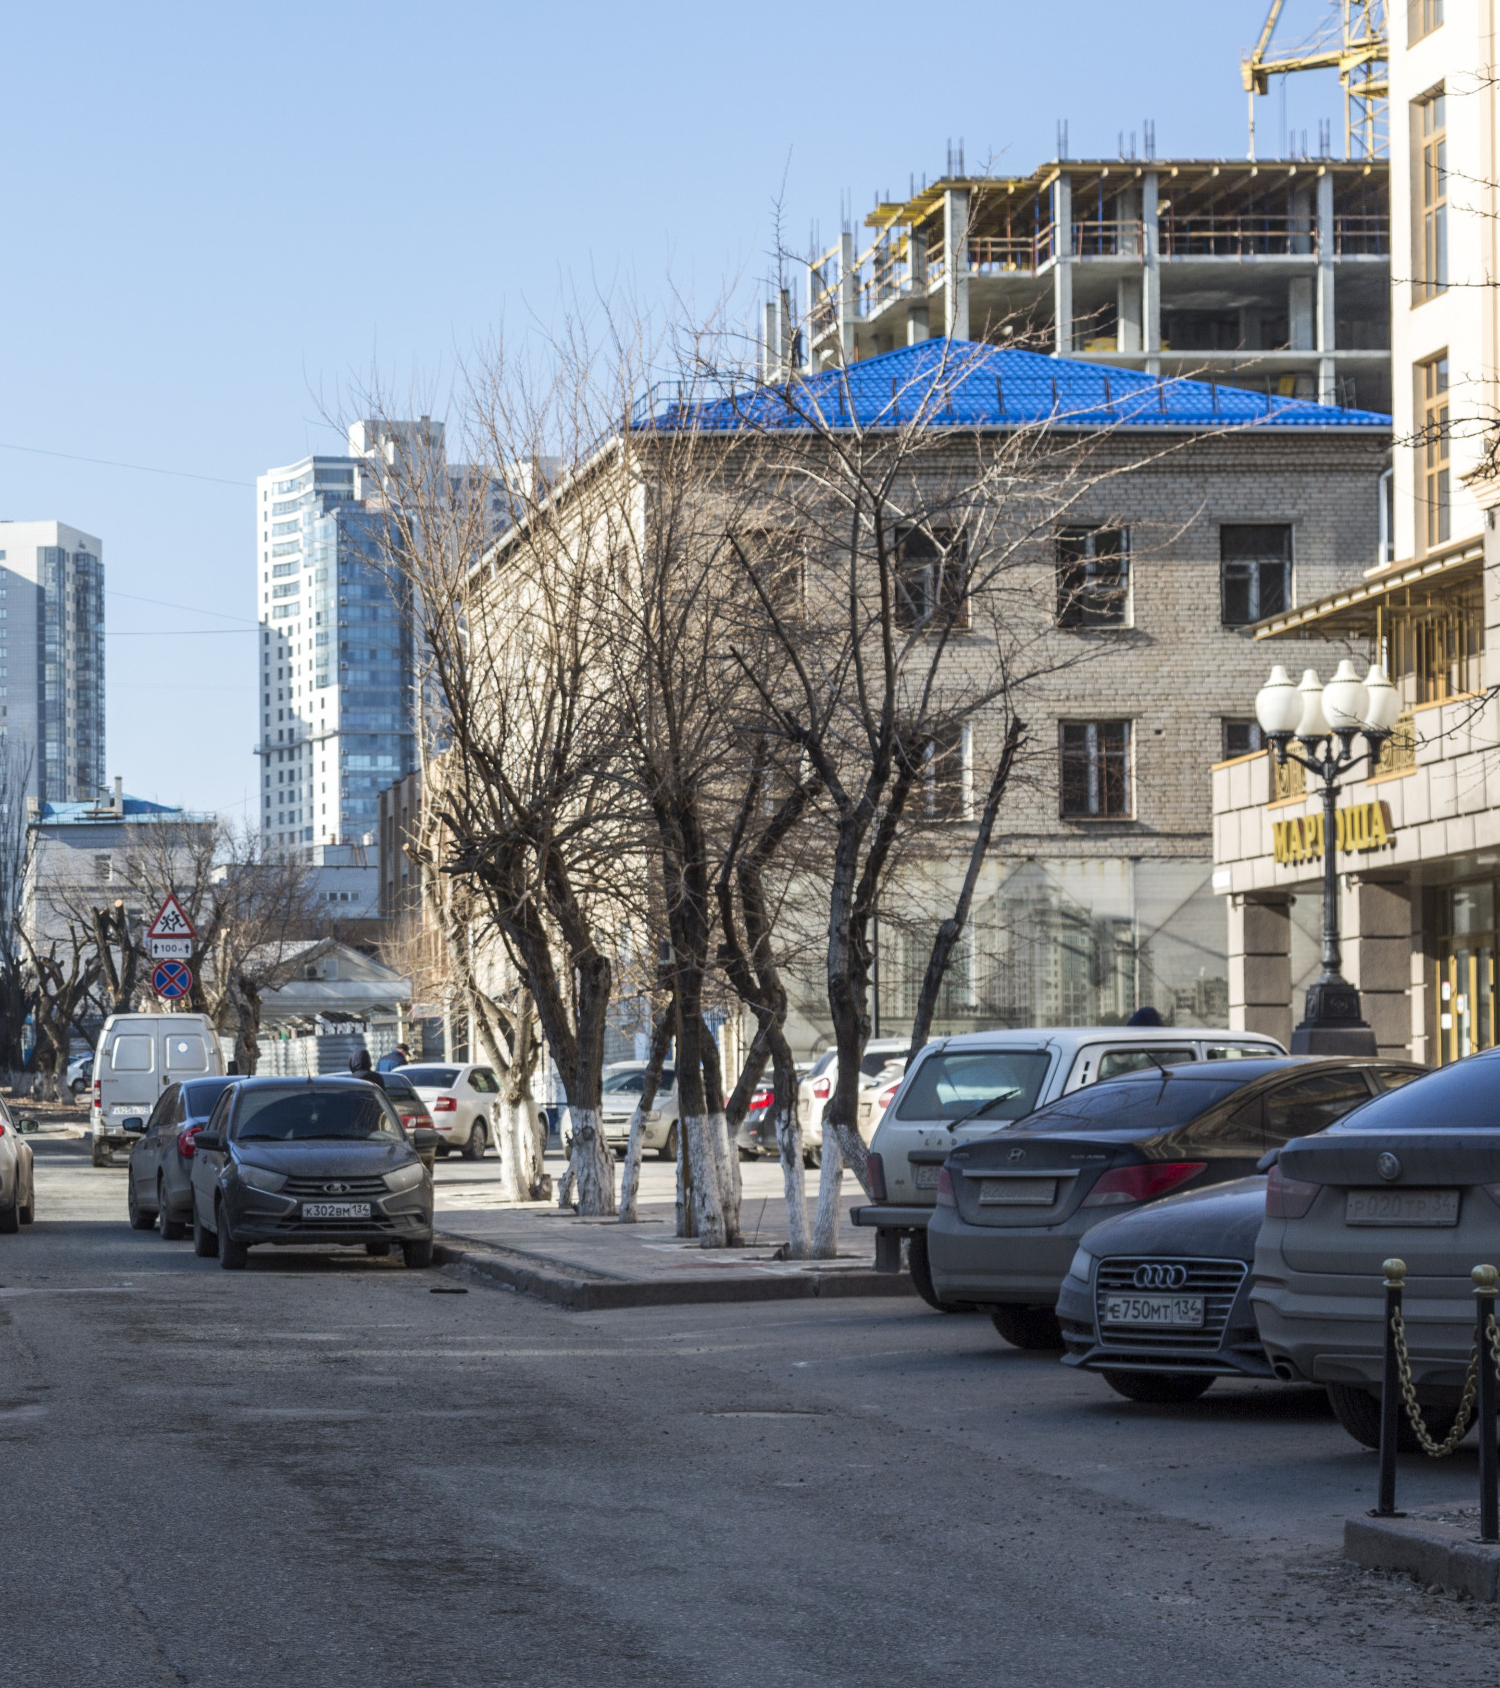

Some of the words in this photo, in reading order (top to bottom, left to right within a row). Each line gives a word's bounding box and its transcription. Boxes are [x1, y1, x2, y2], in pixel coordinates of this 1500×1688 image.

[161, 944, 177, 952] 100
[924, 1138, 969, 1146] LAD
[352, 1205, 369, 1213] 134
[1174, 1299, 1200, 1315] 134
